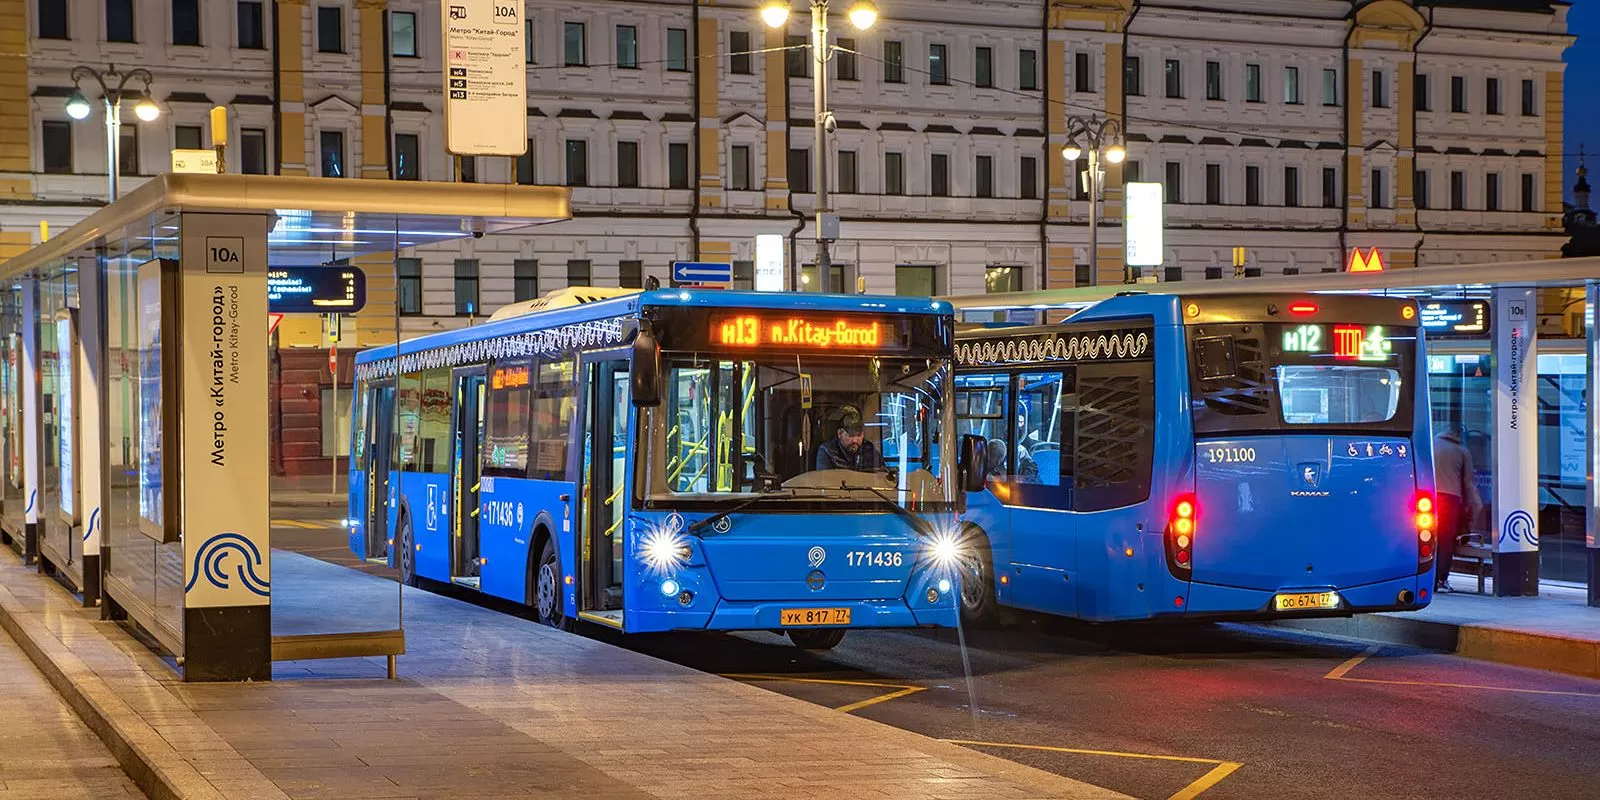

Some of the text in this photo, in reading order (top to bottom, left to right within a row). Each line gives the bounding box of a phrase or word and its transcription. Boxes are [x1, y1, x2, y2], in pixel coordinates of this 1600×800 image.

[449, 27, 471, 35] Метро
[210, 247, 239, 263] 10А
[228, 285, 241, 384] Metro Kitay-Gorod
[210, 285, 227, 467] Метро «Китай-город»
[1510, 400, 1519, 430] Метро
[1209, 447, 1256, 463] 191100
[488, 500, 513, 527] 171436
[846, 551, 903, 567] 171436
[1298, 595, 1316, 606] 674
[1320, 594, 1330, 602] 77
[806, 610, 829, 623] 817
[835, 609, 847, 619] 77
